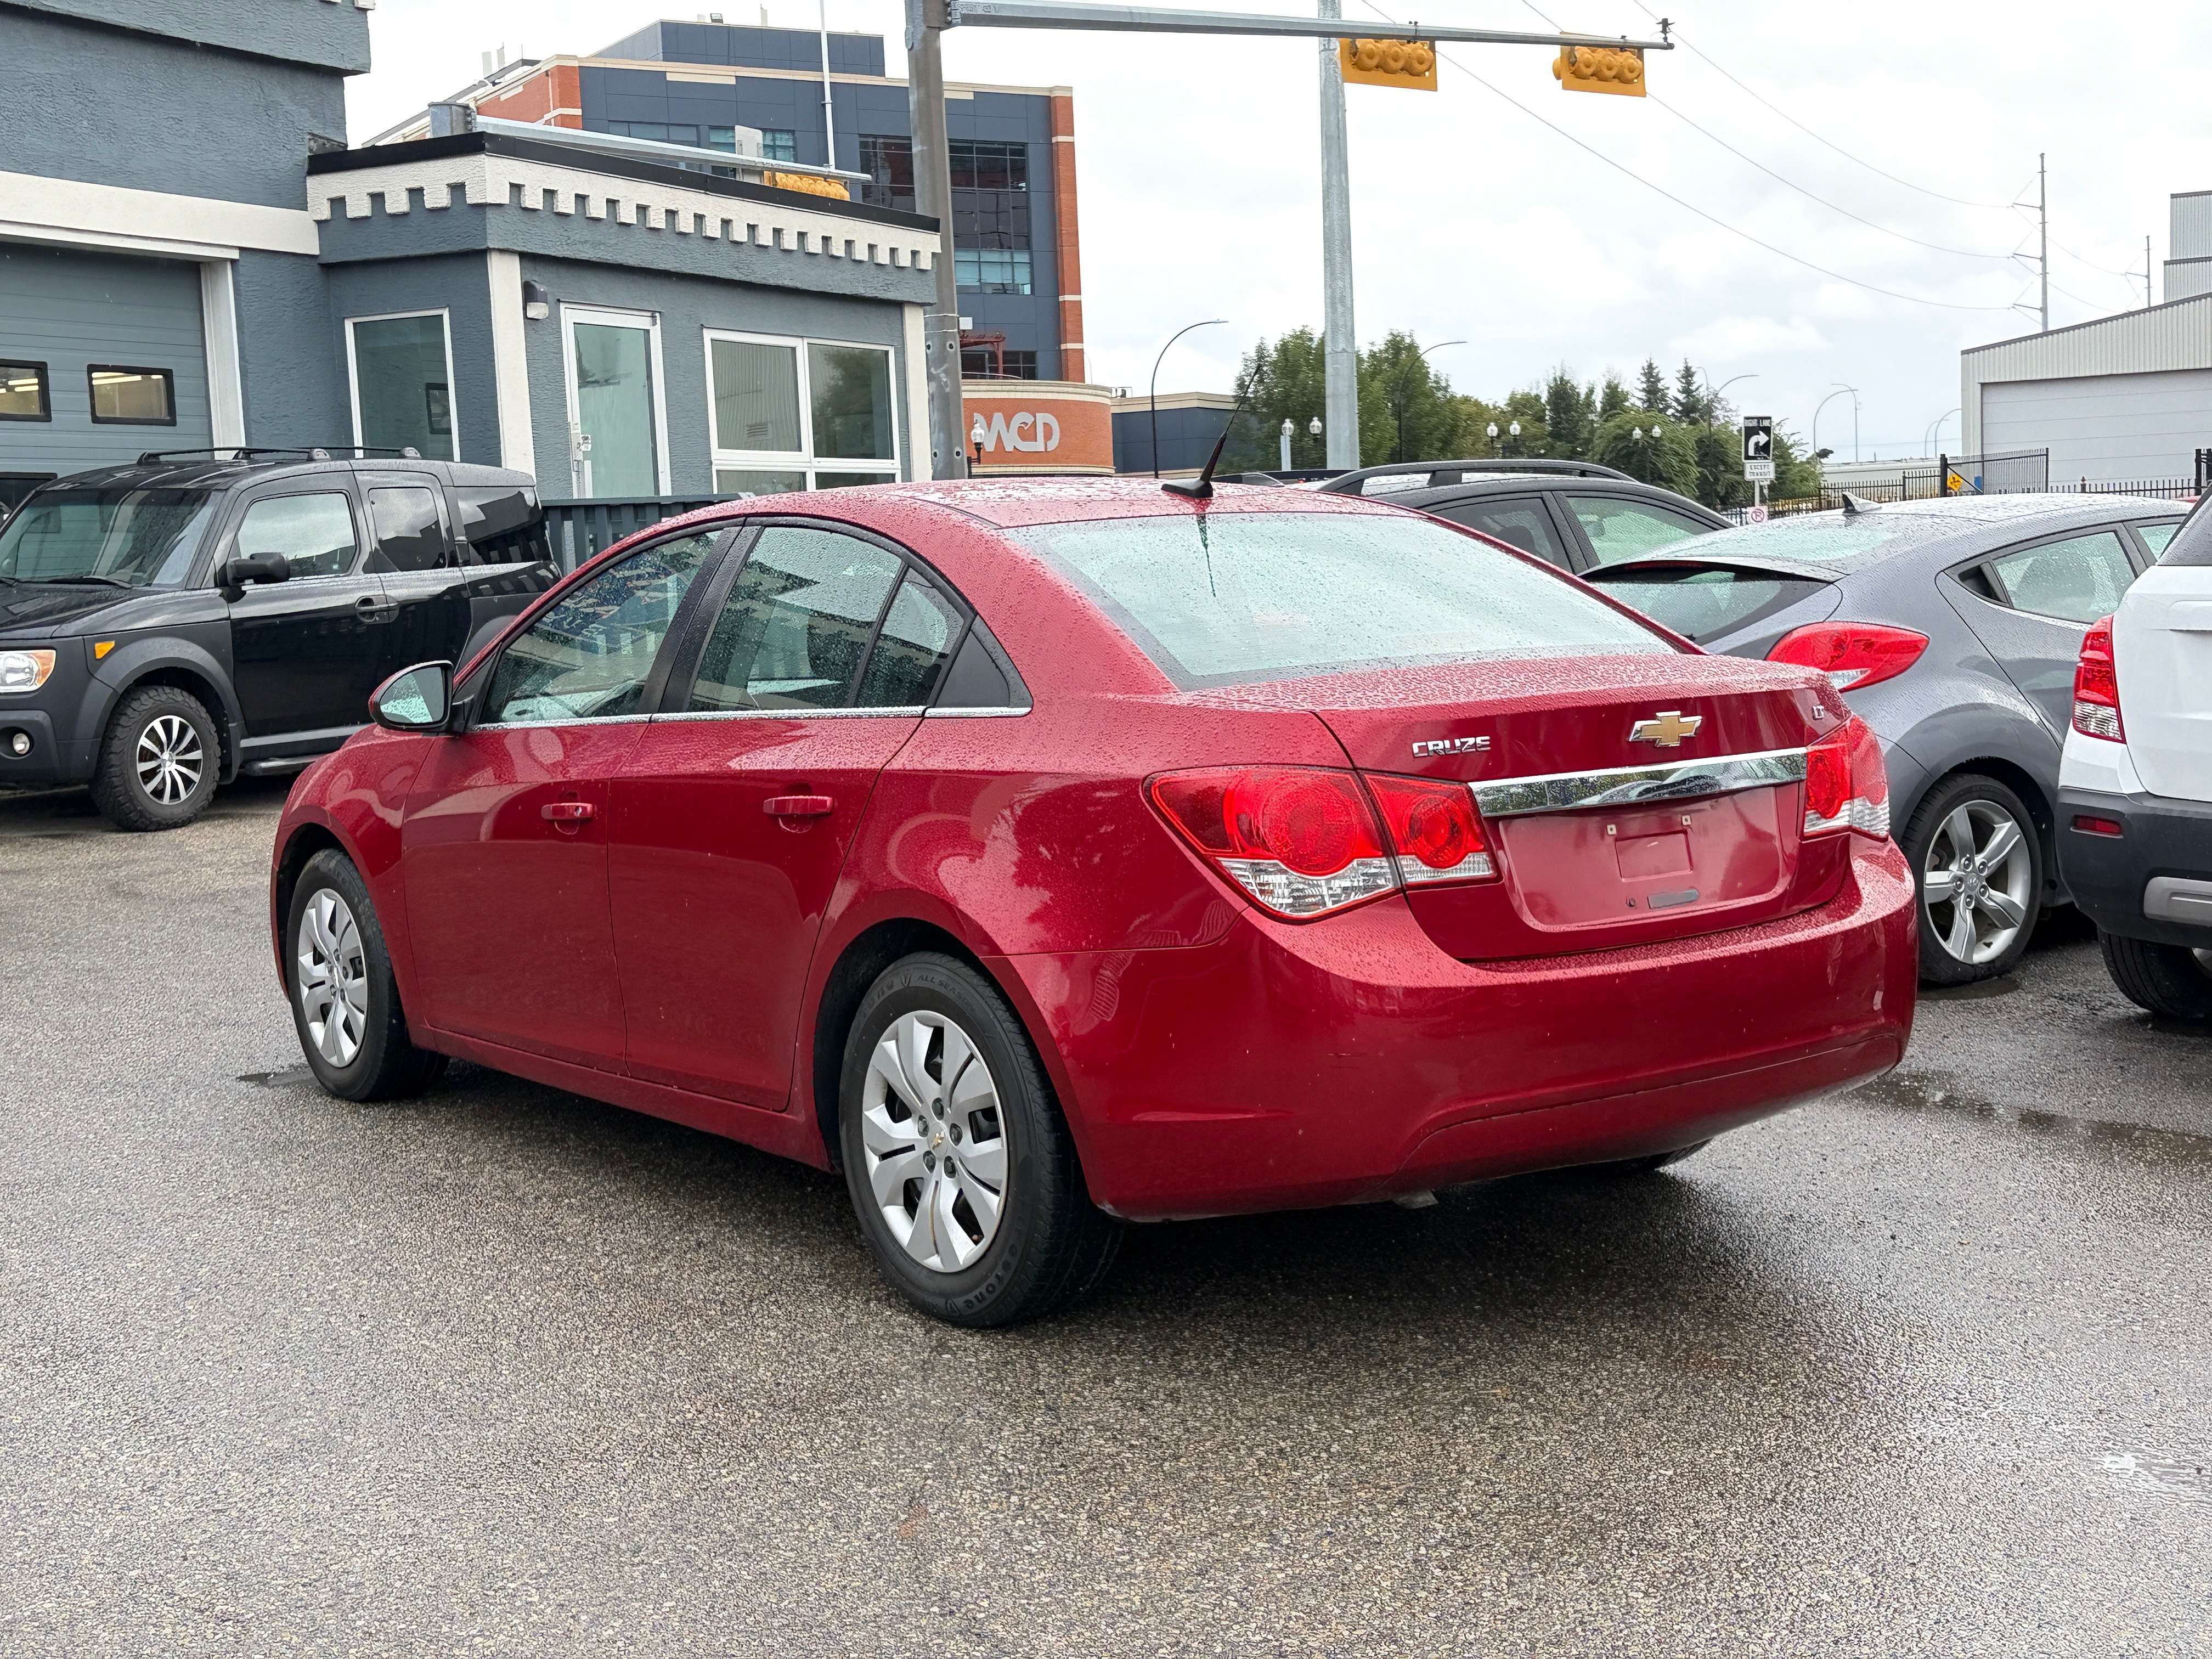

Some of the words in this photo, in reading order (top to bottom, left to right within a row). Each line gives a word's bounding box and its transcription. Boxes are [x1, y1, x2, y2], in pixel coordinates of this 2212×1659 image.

[1812, 706, 1824, 719] LT
[1412, 736, 1491, 758] CRUZE
[917, 974, 935, 984] ALL
